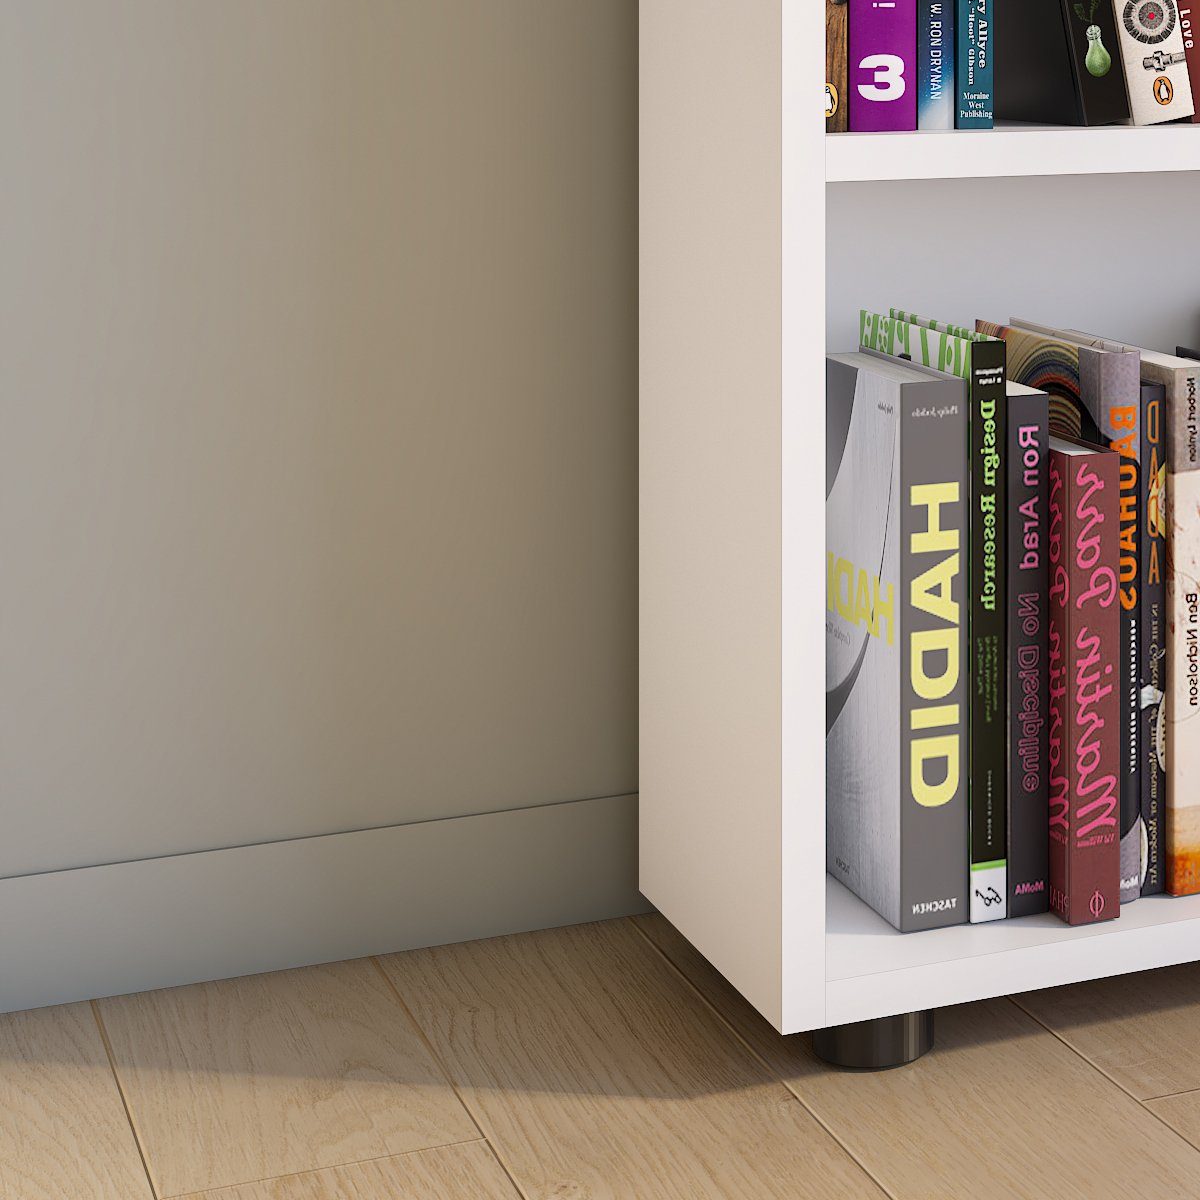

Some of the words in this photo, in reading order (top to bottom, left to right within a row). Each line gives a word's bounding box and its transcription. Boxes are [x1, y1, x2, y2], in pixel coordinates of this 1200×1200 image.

[930, 3, 942, 17] W.
[930, 21, 942, 46] RON
[976, 19, 988, 69] Allyce
[1179, 8, 1194, 49] Love
[857, 54, 906, 102] 3
[930, 49, 942, 100] DRYNAN
[960, 110, 993, 119] Publishing
[968, 101, 985, 109] West
